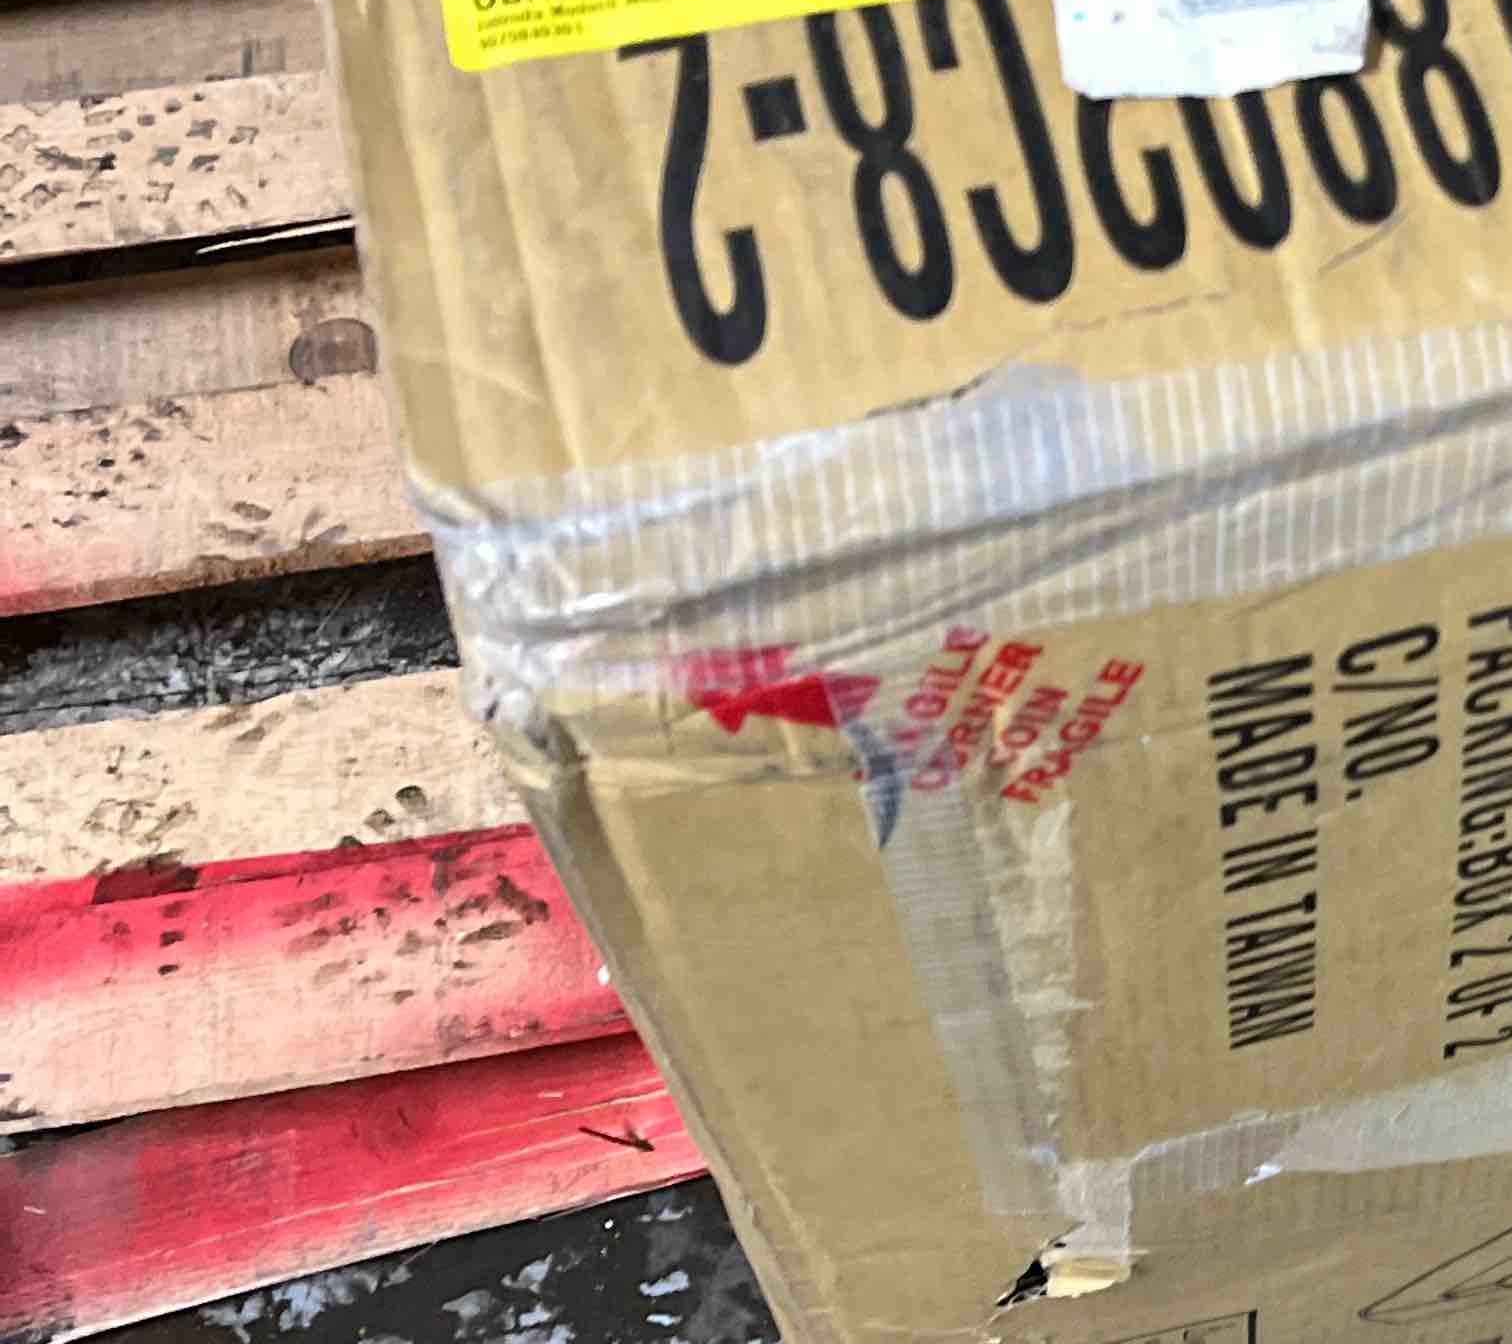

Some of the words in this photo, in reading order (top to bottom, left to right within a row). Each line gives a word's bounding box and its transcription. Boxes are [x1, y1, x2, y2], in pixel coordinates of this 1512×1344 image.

[1002, 657, 1146, 804] FRAGILE
[1207, 653, 1319, 830] MADE
[1331, 623, 1440, 803] C/NO.
[1222, 827, 1319, 894] IN
[1225, 890, 1319, 1051] TAIWAN
